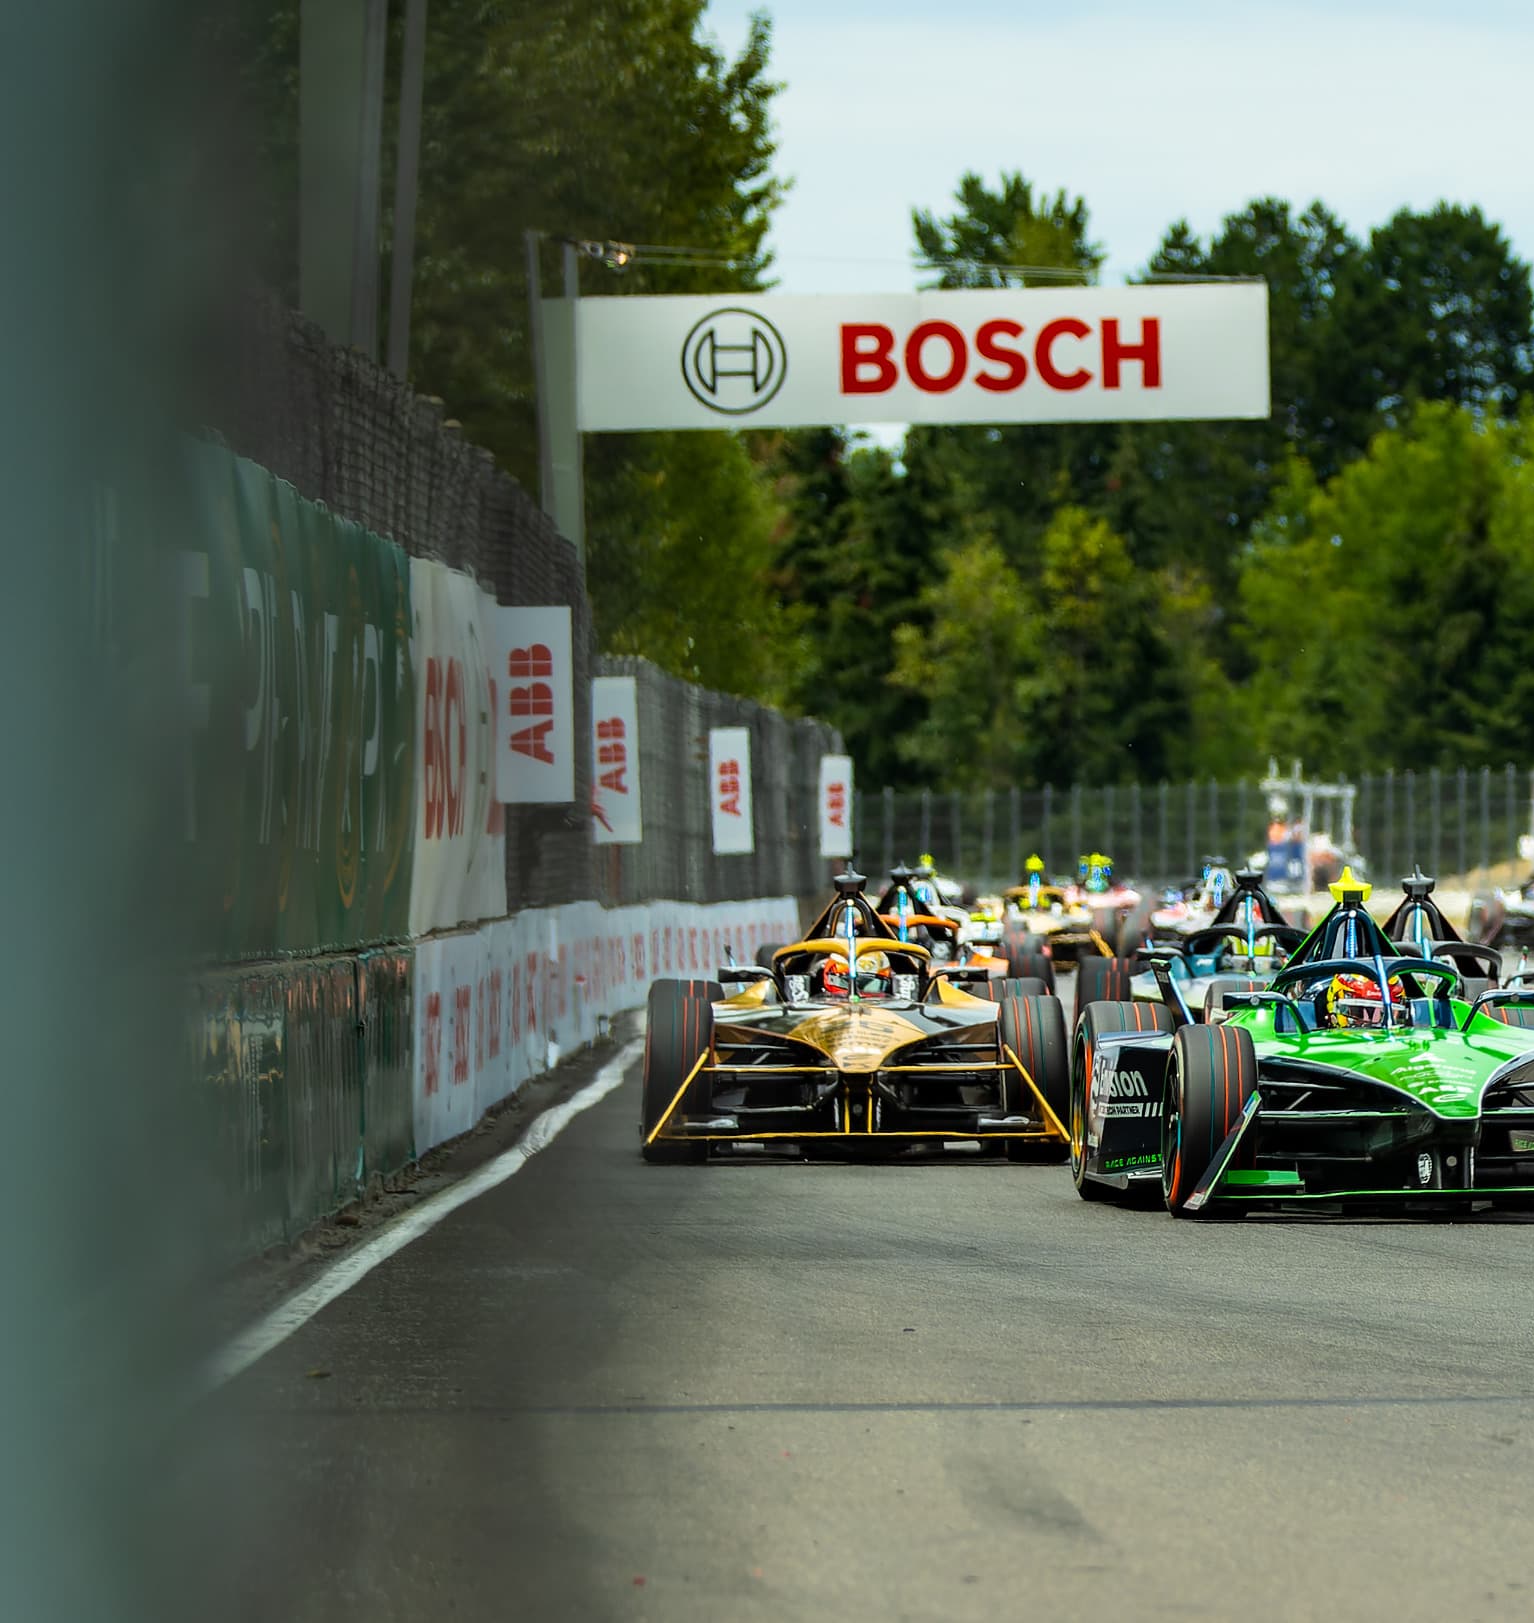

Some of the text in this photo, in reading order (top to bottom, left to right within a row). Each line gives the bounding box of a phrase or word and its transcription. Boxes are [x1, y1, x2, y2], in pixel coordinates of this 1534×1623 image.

[839, 316, 1162, 395] BOSCH
[508, 642, 555, 765] ABB
[596, 715, 629, 795] ABB
[718, 758, 742, 818] ABB
[826, 780, 845, 827] ABB
[1105, 1153, 1162, 1169] RACE AGAINST
